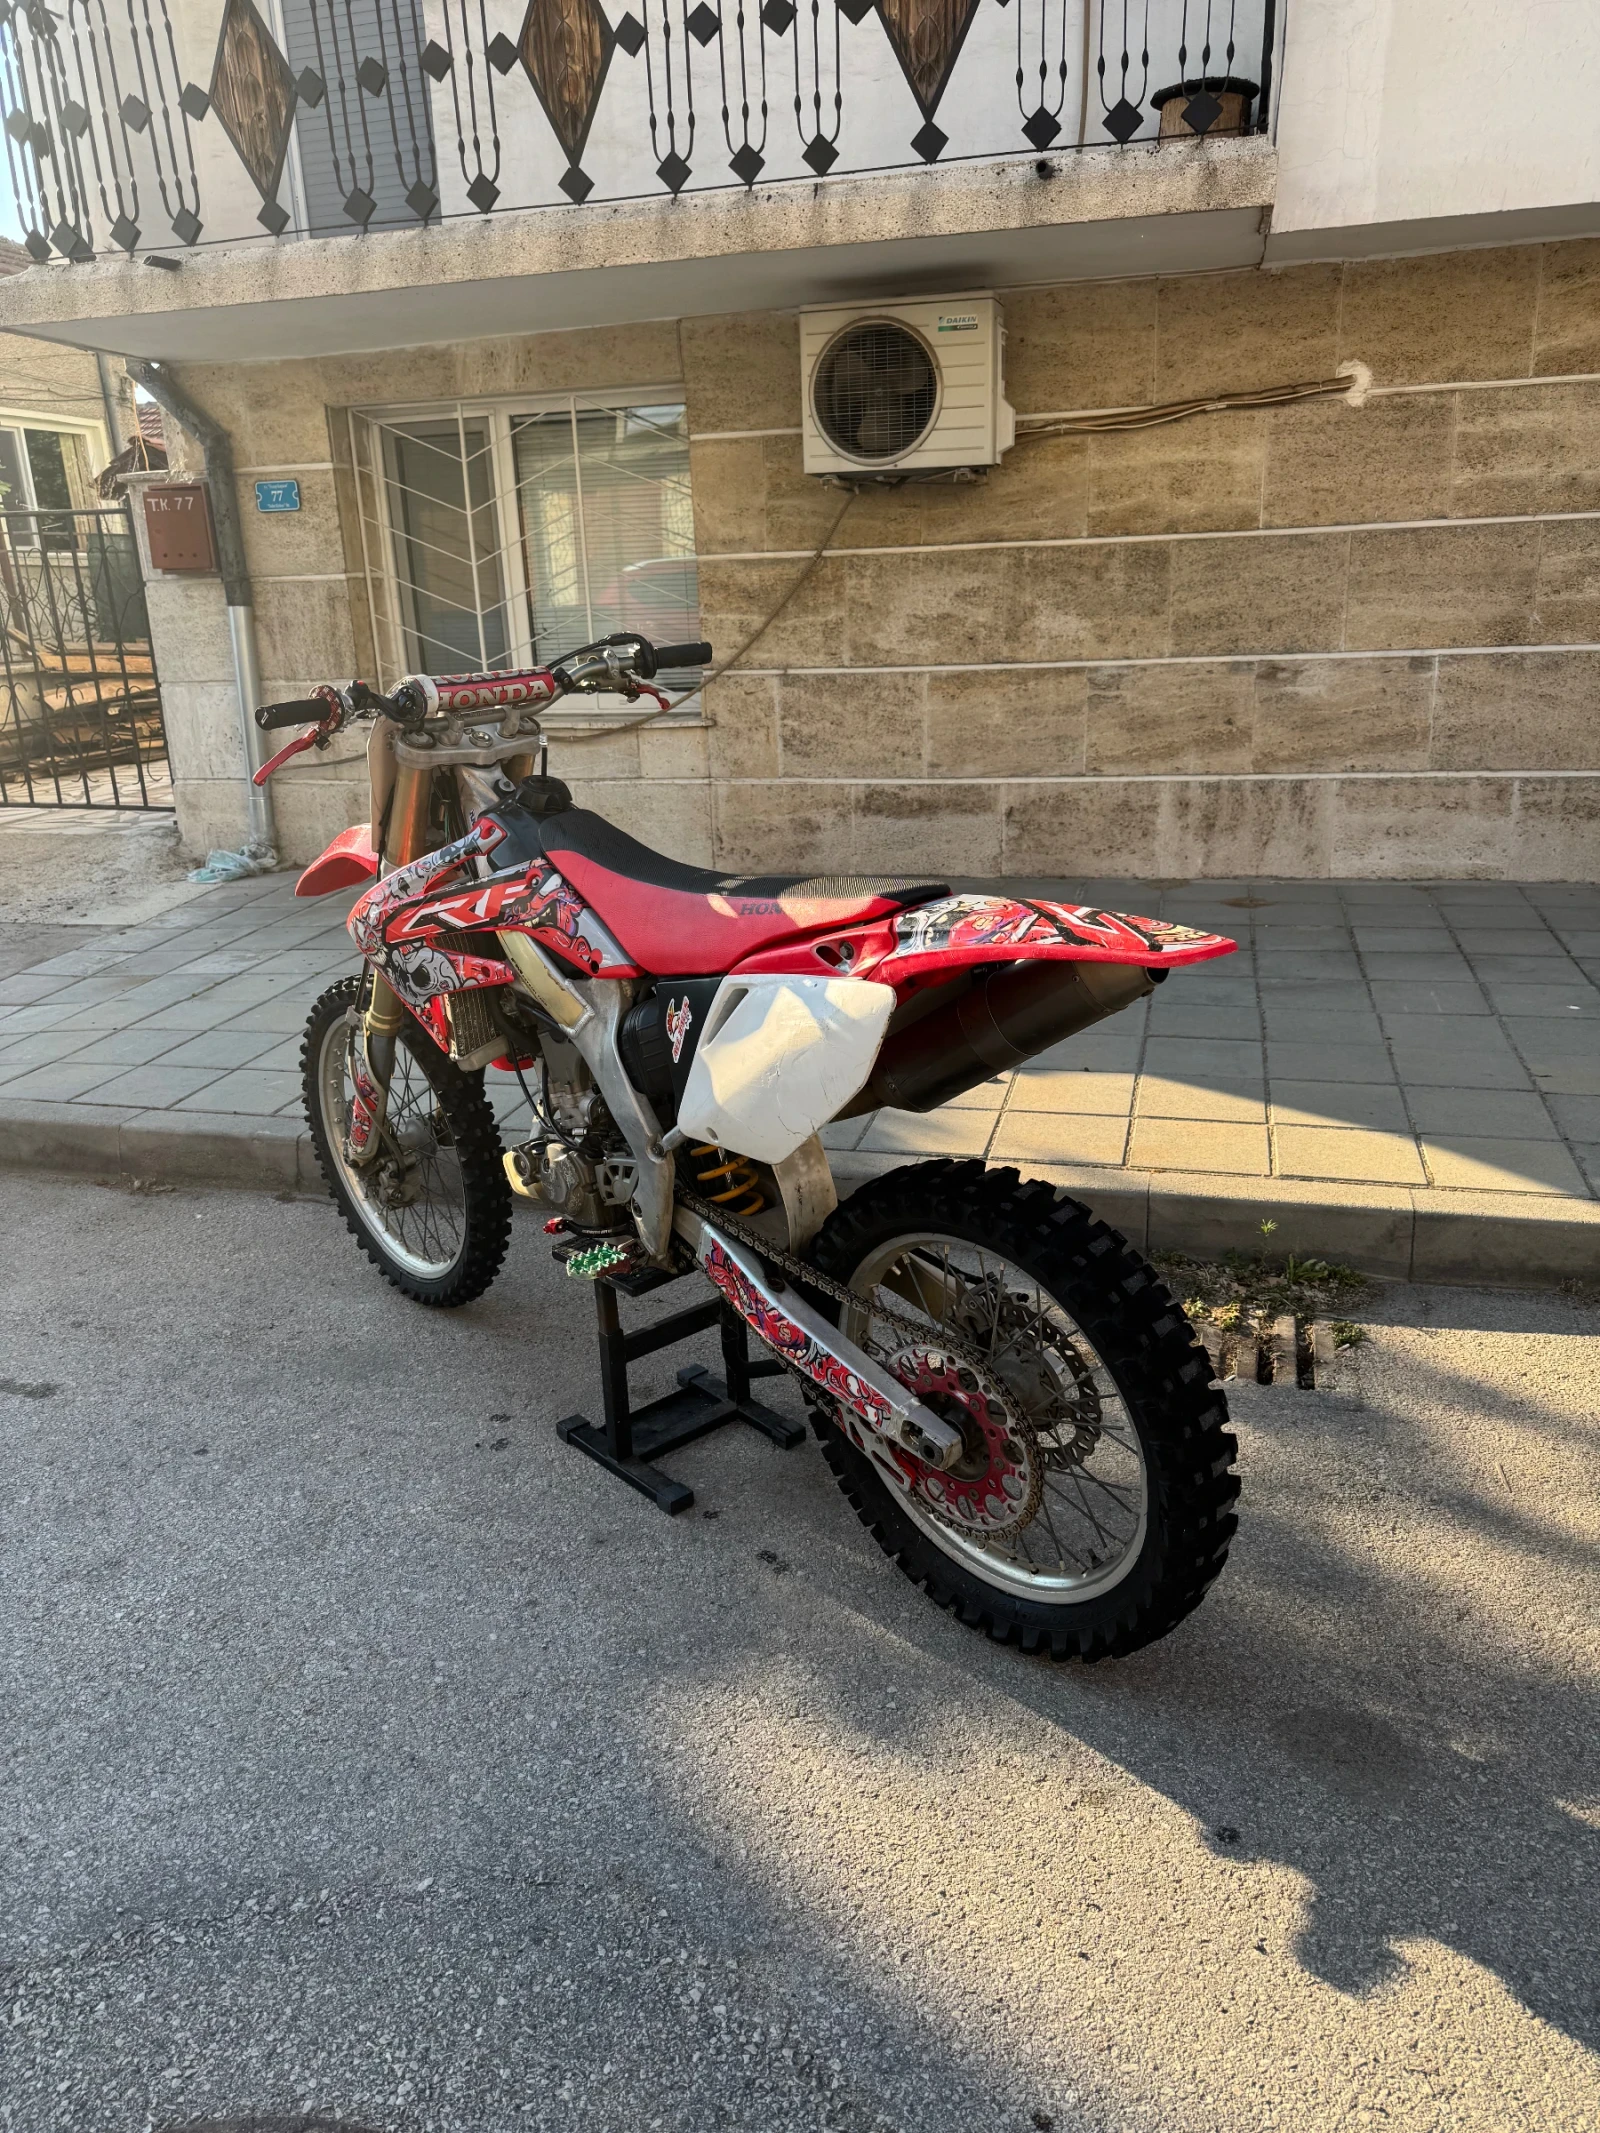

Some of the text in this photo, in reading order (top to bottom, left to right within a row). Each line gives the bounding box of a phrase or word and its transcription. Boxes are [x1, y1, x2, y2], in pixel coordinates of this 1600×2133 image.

[946, 316, 977, 324] DAIKIN
[271, 490, 283, 502] 77
[173, 496, 194, 511] 77
[385, 882, 533, 943] CRF
[739, 902, 790, 916] HON
